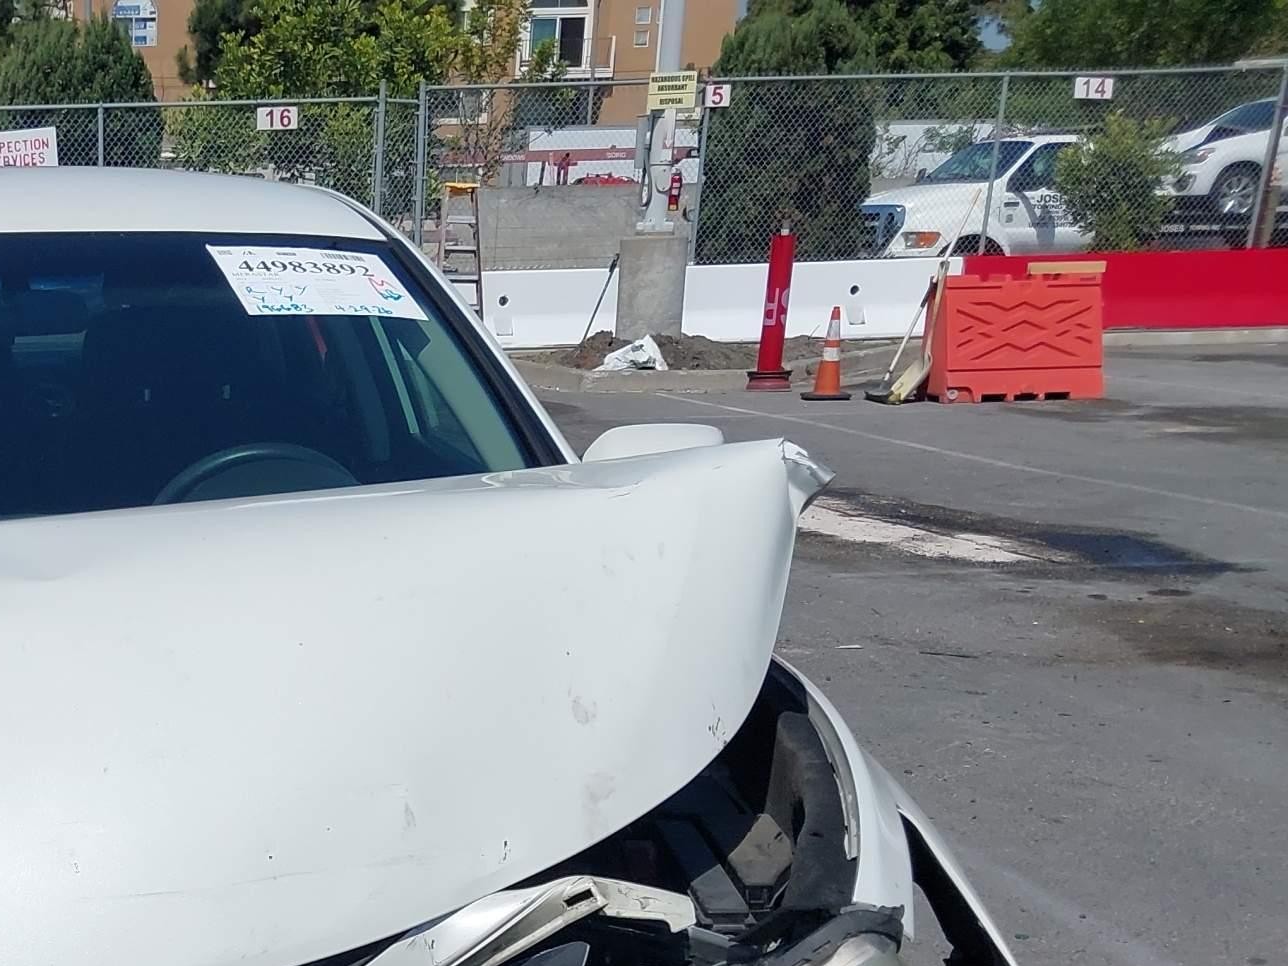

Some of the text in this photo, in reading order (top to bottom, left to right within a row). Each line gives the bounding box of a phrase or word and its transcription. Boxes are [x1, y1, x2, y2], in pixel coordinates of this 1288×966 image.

[1083, 79, 1106, 97] 14
[266, 109, 291, 128] 16
[1159, 224, 1185, 233] JOSES
[238, 260, 375, 277] 44983892
